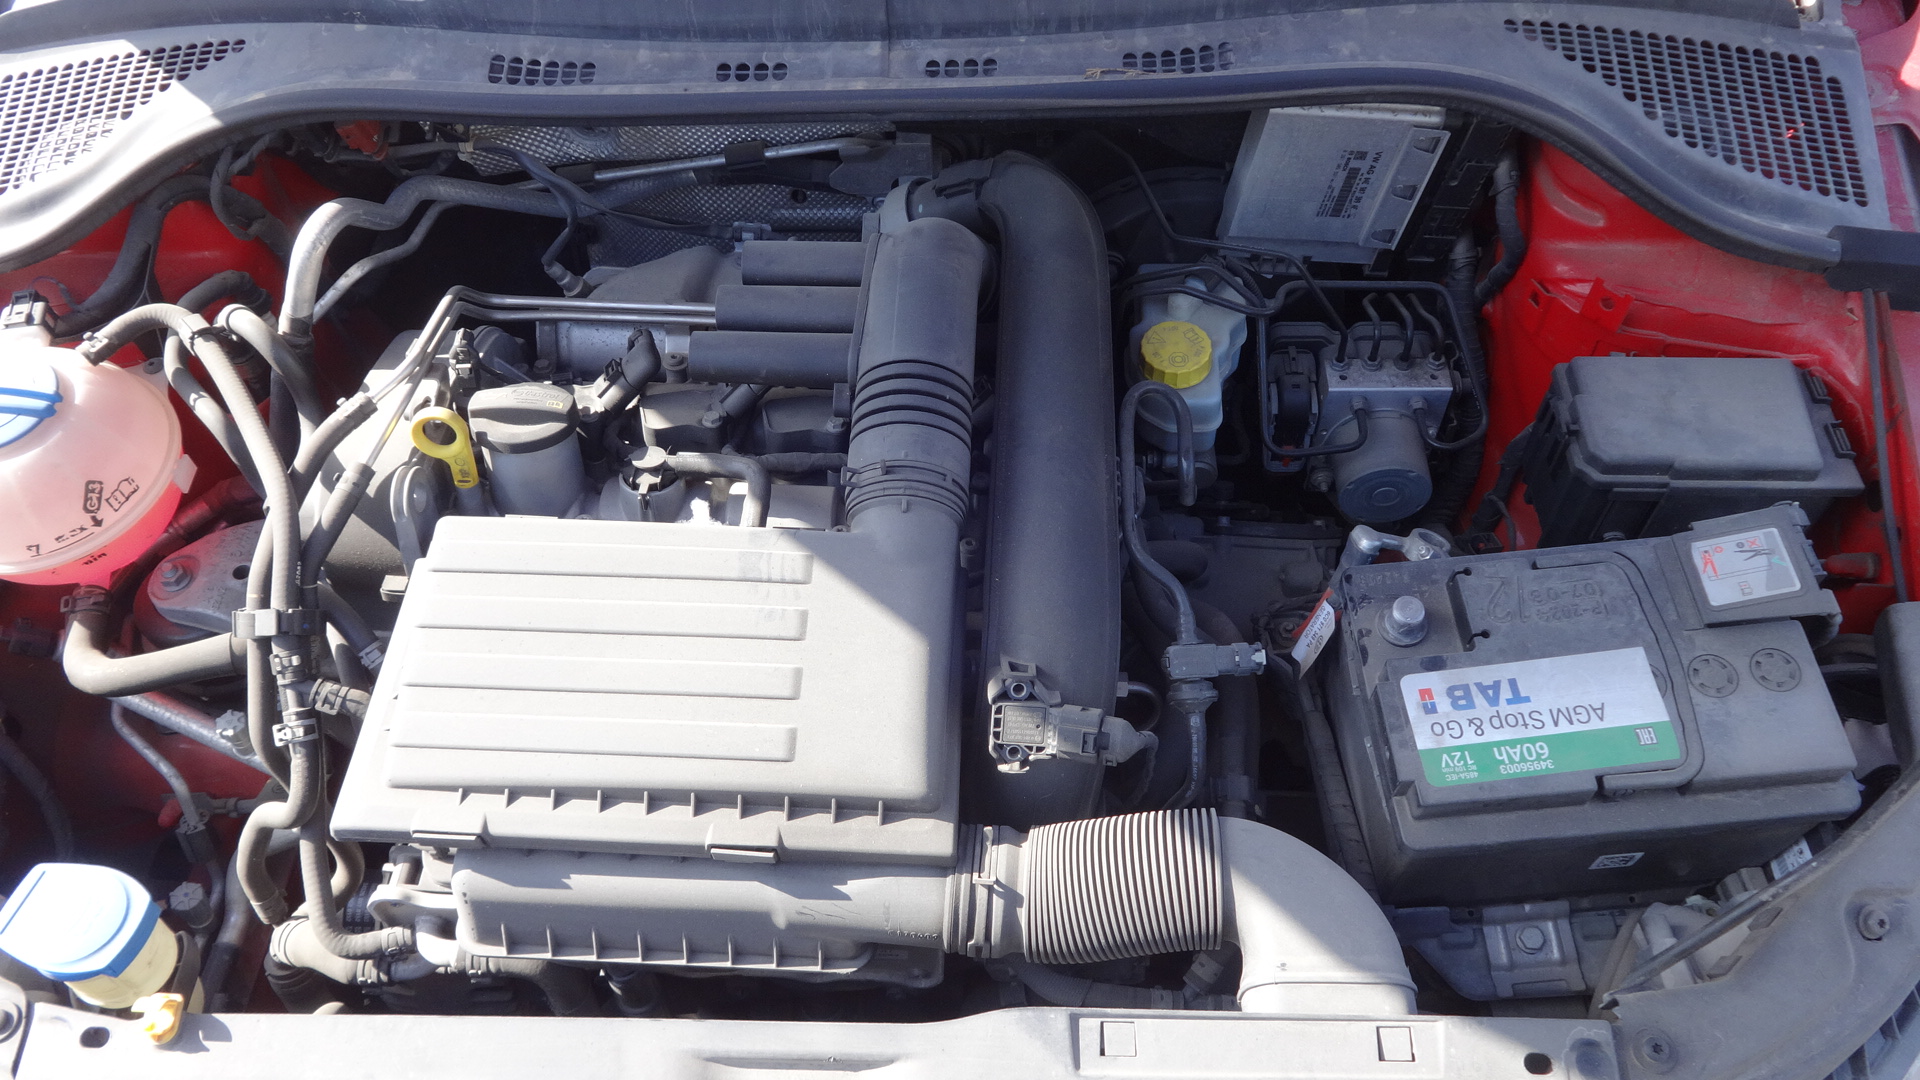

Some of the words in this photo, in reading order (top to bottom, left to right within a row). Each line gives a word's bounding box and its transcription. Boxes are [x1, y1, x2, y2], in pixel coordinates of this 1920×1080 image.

[1372, 151, 1383, 163] VW
[1366, 164, 1376, 175] AG
[1304, 605, 1326, 639] GENERATOR
[1446, 678, 1532, 711] TAB
[1489, 710, 1546, 730] Stop
[1549, 702, 1605, 728] AGM
[1430, 720, 1464, 739] Go
[1466, 717, 1485, 737] &
[1441, 751, 1475, 768] 12V
[1493, 742, 1549, 764] 60Ah
[1500, 760, 1555, 774] 34956003
